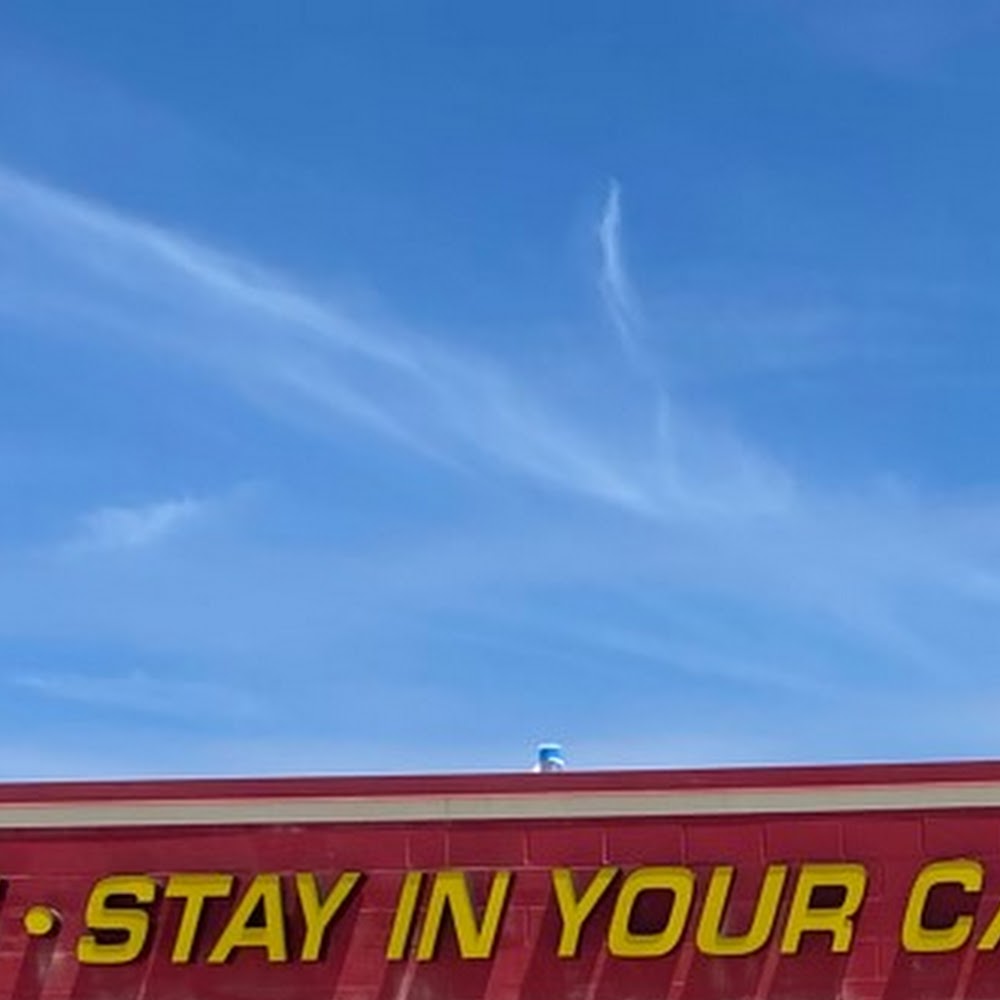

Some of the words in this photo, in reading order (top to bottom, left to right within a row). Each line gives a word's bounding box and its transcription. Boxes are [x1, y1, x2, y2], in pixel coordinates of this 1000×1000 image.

[76, 871, 362, 965] STAY
[385, 870, 511, 962] IN
[551, 863, 867, 960] YOUR
